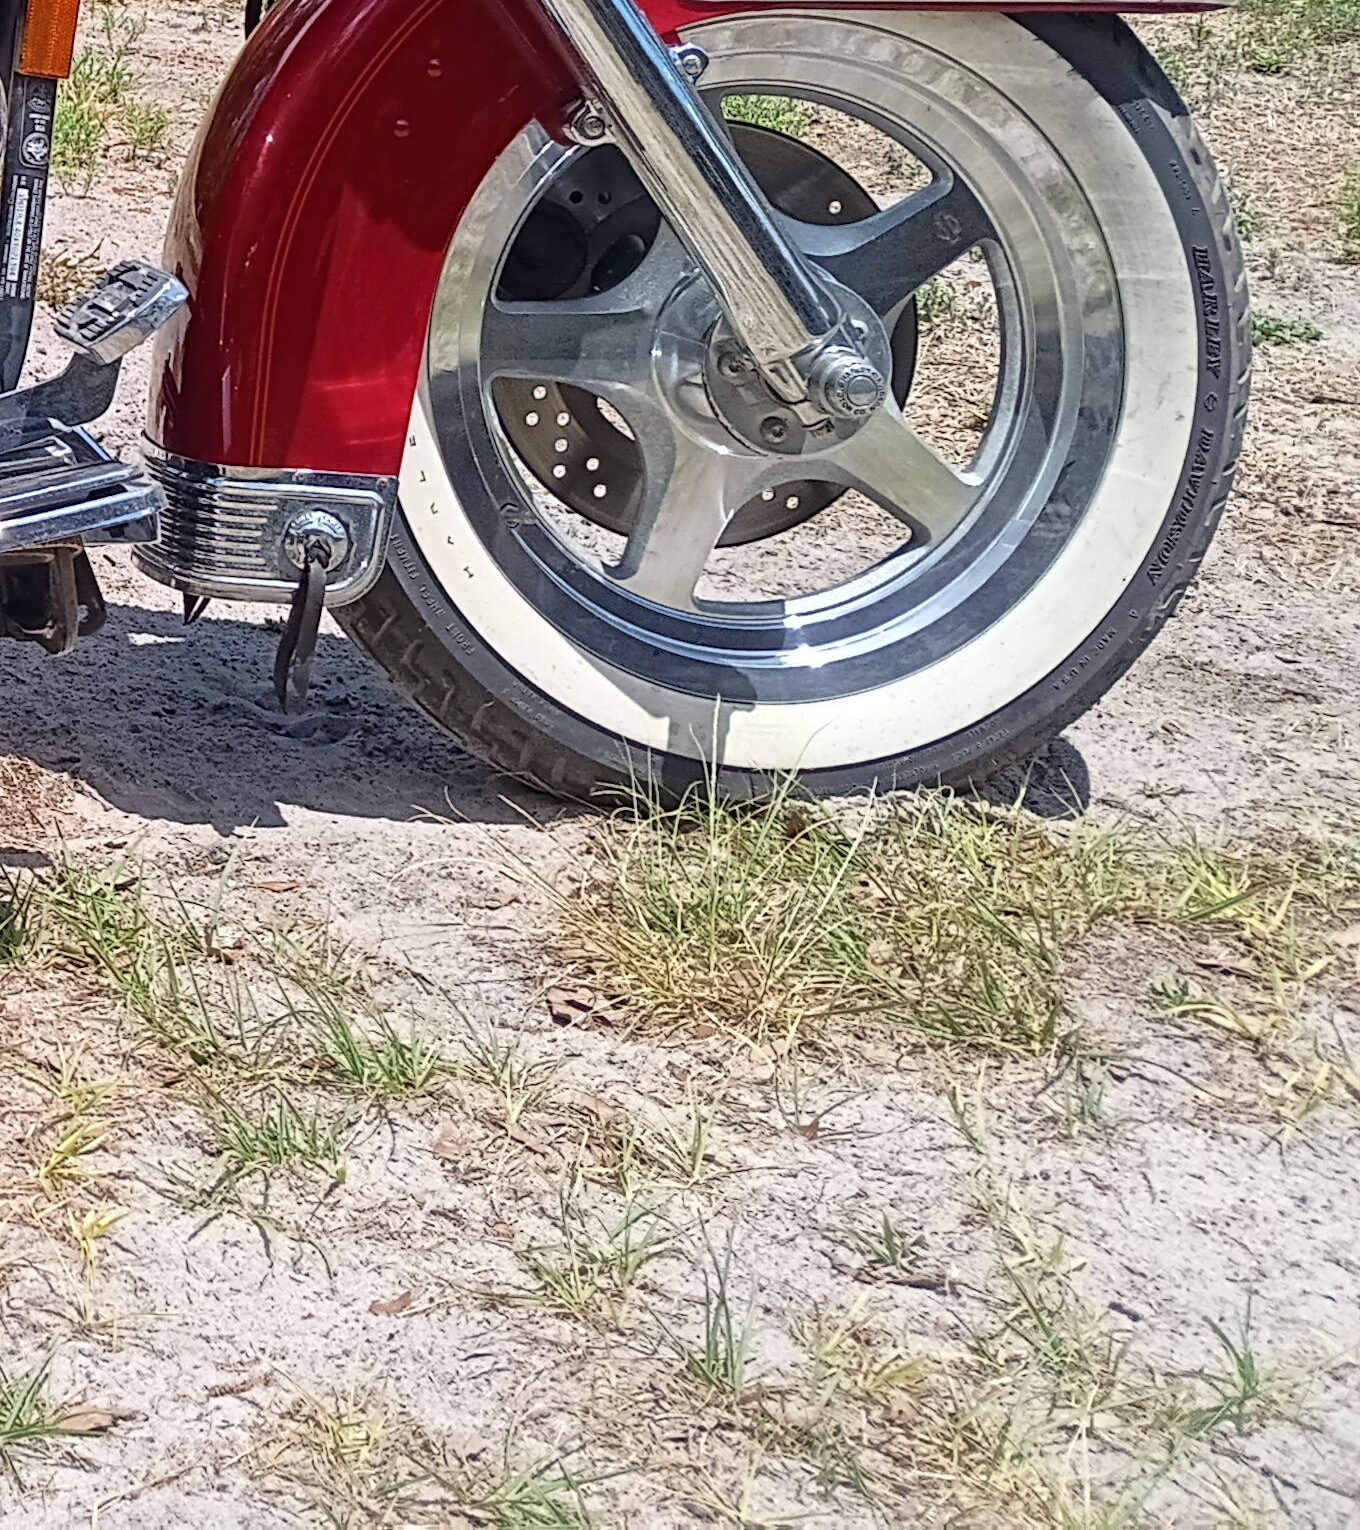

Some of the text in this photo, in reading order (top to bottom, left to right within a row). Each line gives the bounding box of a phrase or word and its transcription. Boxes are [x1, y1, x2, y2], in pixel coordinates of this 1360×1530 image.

[1147, 245, 1220, 587] HARLEY DAVIDSON
[408, 434, 475, 579] HARLE
[388, 533, 476, 657] FRONT WHEEL FITMENT
[1089, 627, 1117, 656] MADE
[1077, 653, 1092, 669] IN
